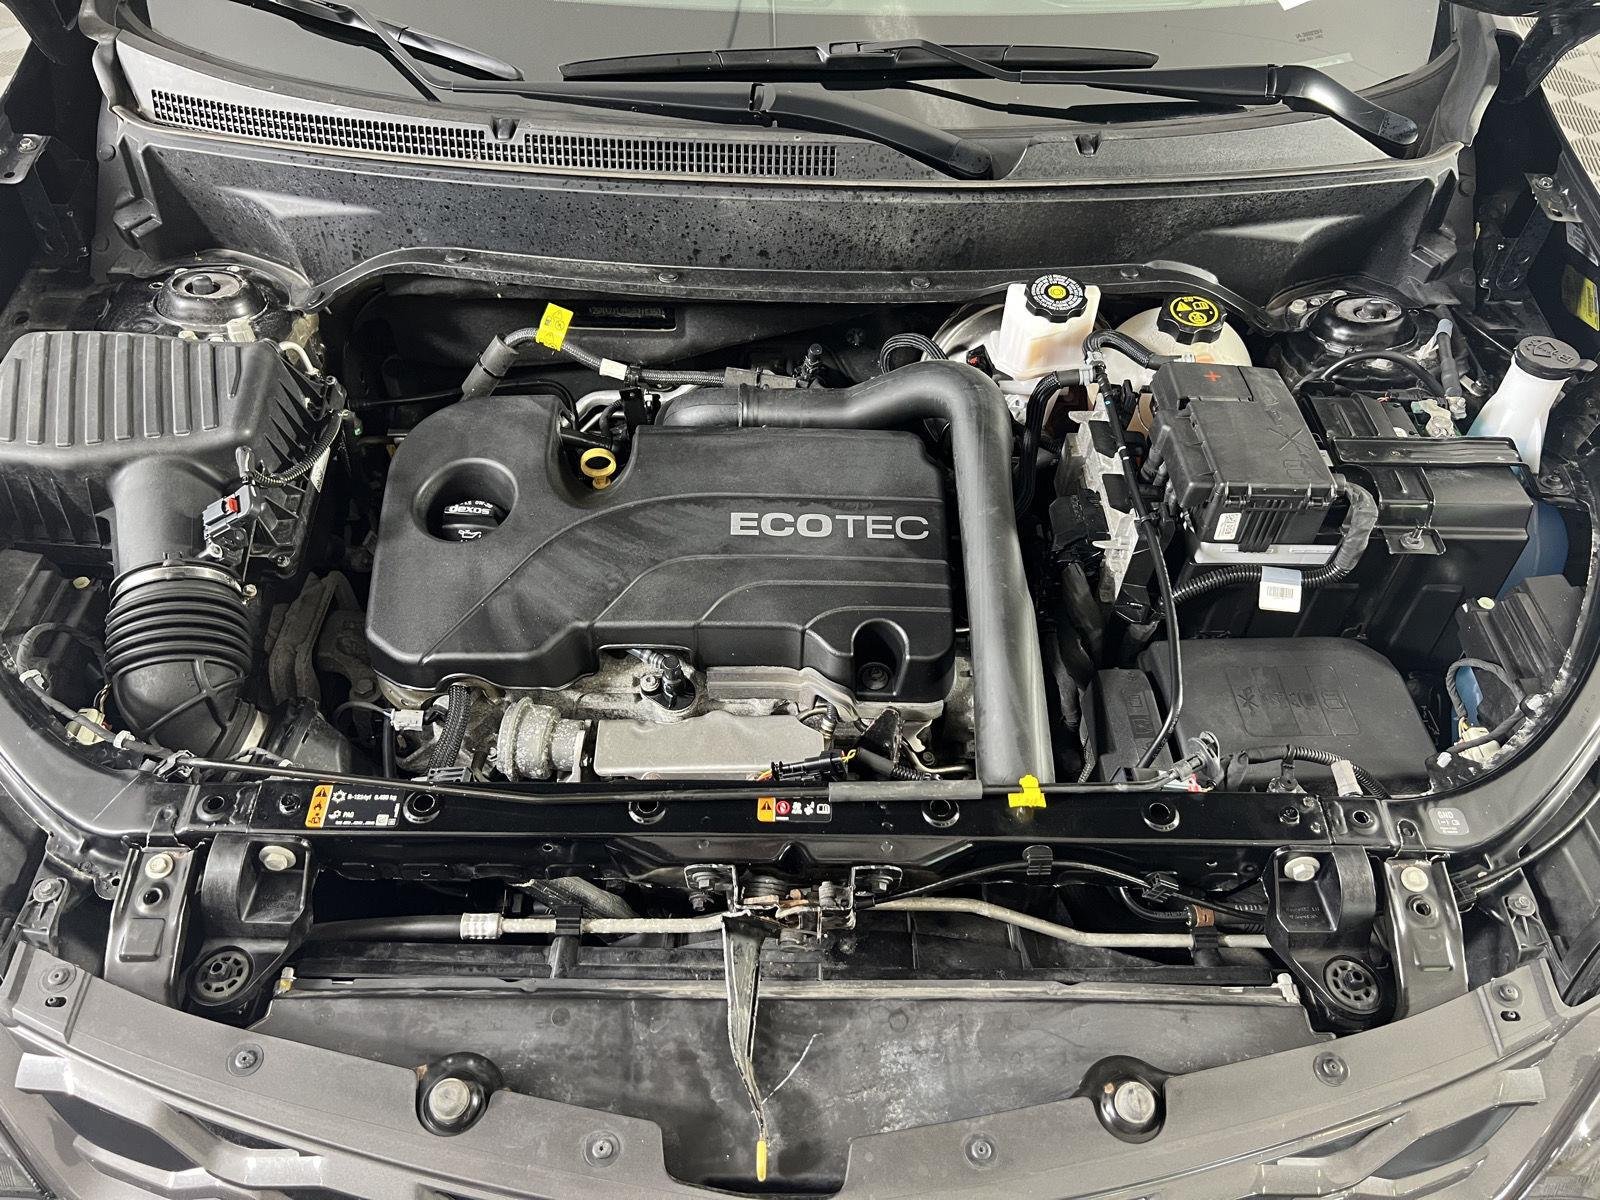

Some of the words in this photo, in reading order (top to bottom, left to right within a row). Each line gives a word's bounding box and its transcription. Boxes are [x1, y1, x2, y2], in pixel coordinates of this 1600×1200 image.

[449, 504, 490, 514] dexos
[730, 512, 930, 540] ECOTEC
[1437, 810, 1454, 819] GND
